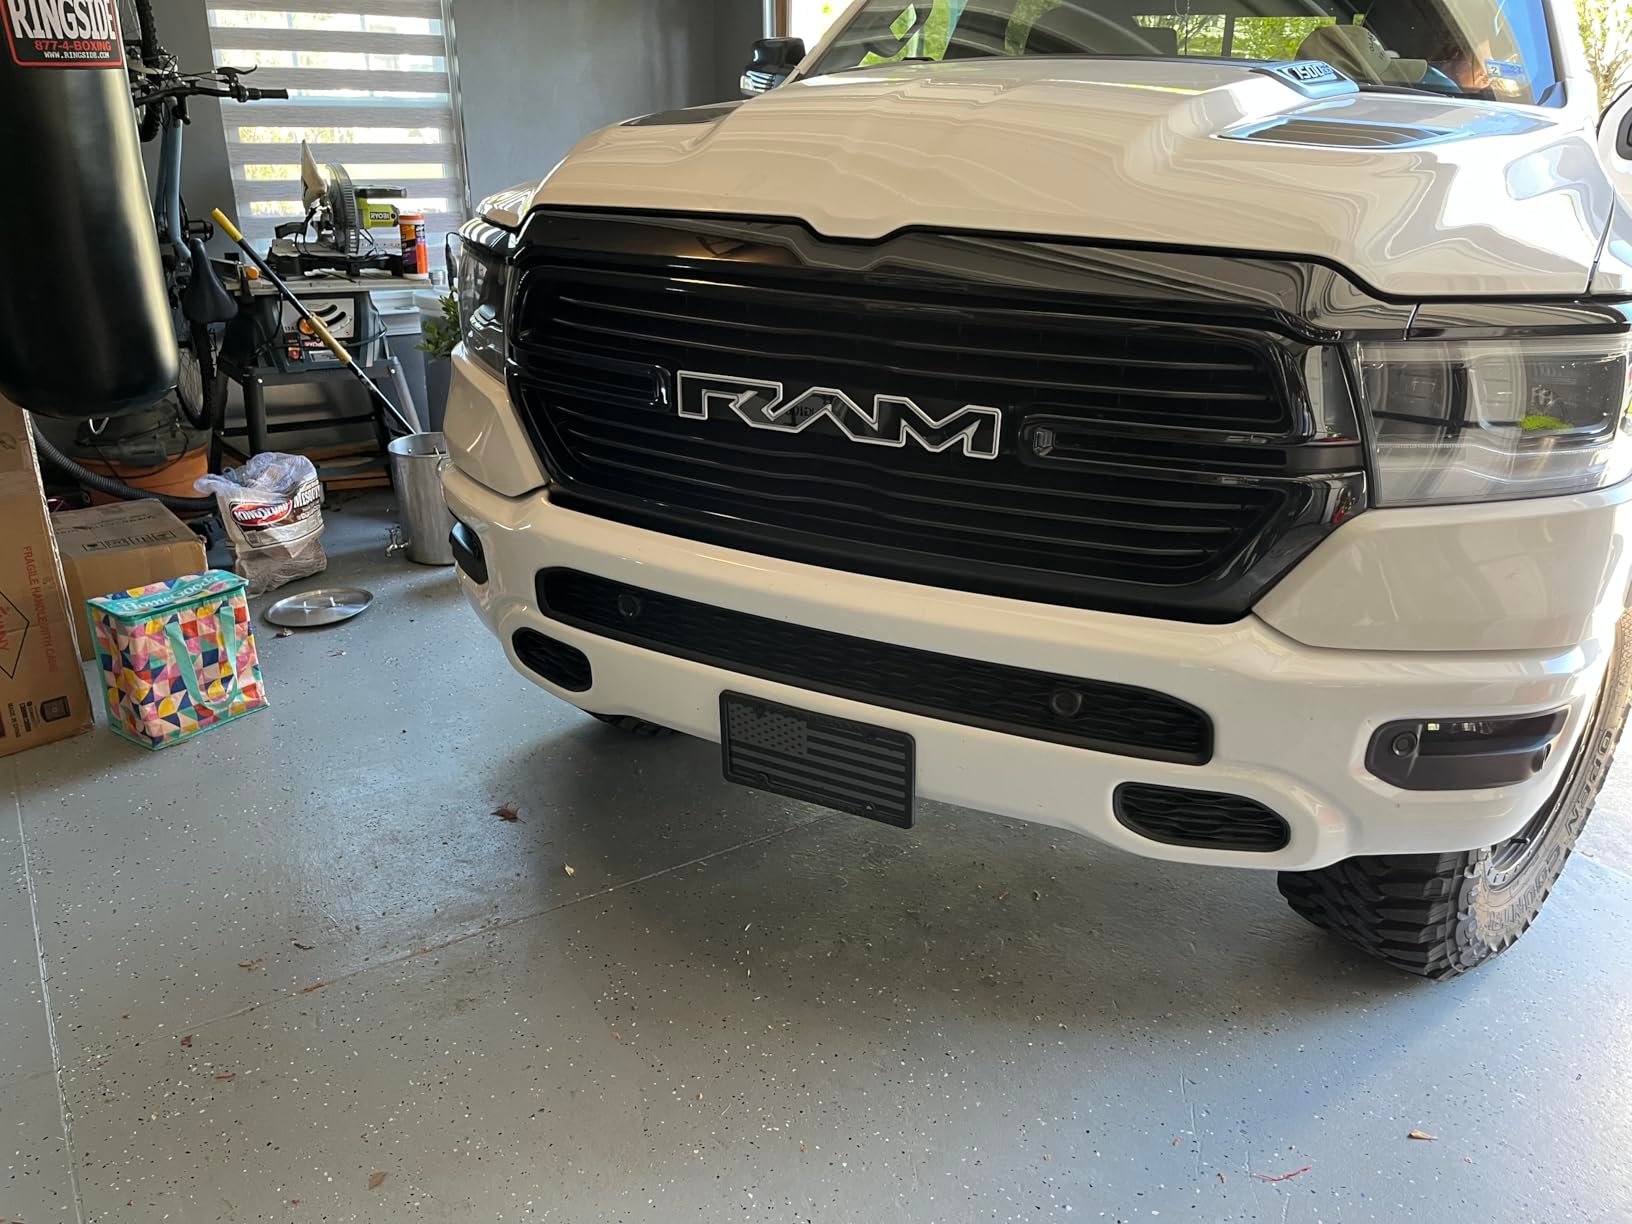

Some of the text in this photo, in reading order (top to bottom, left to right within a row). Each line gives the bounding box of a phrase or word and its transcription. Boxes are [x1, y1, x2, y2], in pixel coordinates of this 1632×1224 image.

[7, 0, 117, 40] RINGSIDE
[35, 40, 112, 51] 877-4-BOXING
[1292, 64, 1324, 80] 1500
[370, 212, 390, 220] RYOBI
[677, 370, 1001, 460] RAM
[22, 546, 38, 585] FRAGILE
[31, 587, 47, 623] HANDLE
